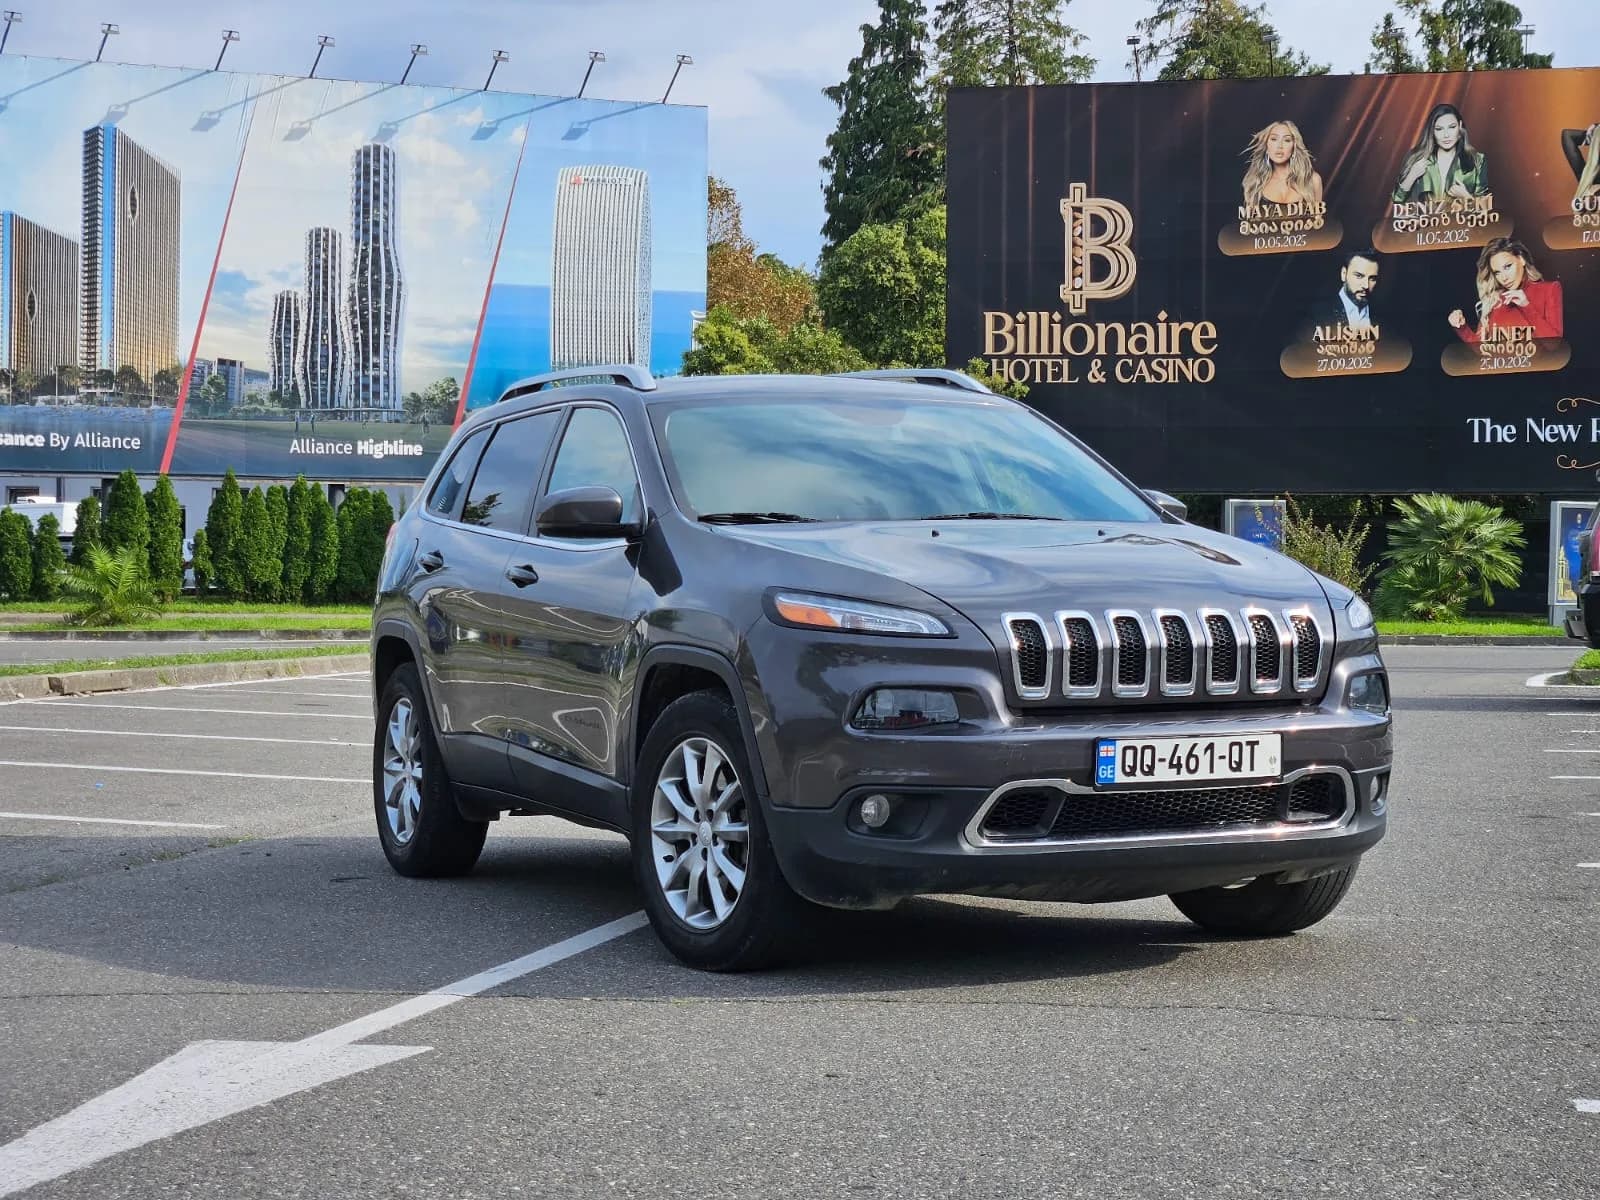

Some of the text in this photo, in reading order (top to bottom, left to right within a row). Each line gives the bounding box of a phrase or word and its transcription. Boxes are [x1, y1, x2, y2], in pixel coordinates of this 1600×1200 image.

[1238, 204, 1283, 220] MAYA
[1254, 234, 1307, 250] 10.05.2025
[1416, 229, 1470, 246] 11.05.2025
[982, 310, 1218, 356] Billionaire
[991, 357, 1216, 383] HOTEL & CASINO
[1316, 356, 1373, 372] 27.09.2025
[1480, 356, 1532, 370] 25.10.2025
[1466, 418, 1516, 443] The
[1526, 417, 1582, 443] New
[50, 432, 70, 451] By
[74, 432, 141, 449] Alliance
[289, 439, 423, 458] Alliance Highline
[1121, 740, 1259, 778] QQ-461-QT
[1100, 765, 1115, 779] GE
